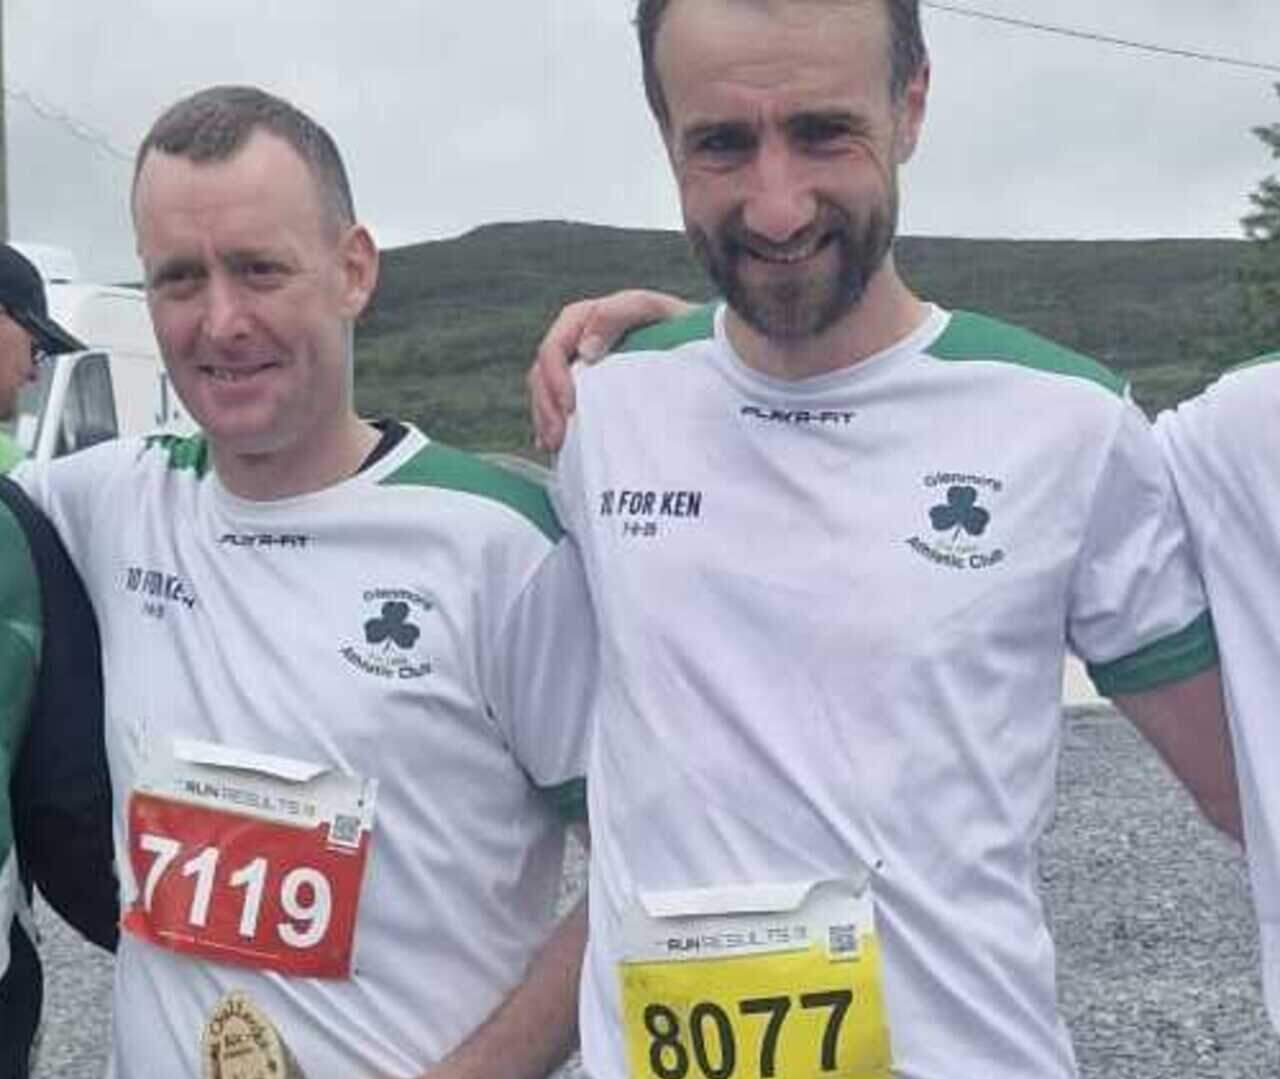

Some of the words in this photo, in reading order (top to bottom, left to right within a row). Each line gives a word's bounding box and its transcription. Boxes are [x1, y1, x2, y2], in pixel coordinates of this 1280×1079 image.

[618, 491, 656, 515] FOR
[660, 491, 701, 516] KEN
[140, 833, 332, 948] 7119
[667, 936, 701, 952] RUN
